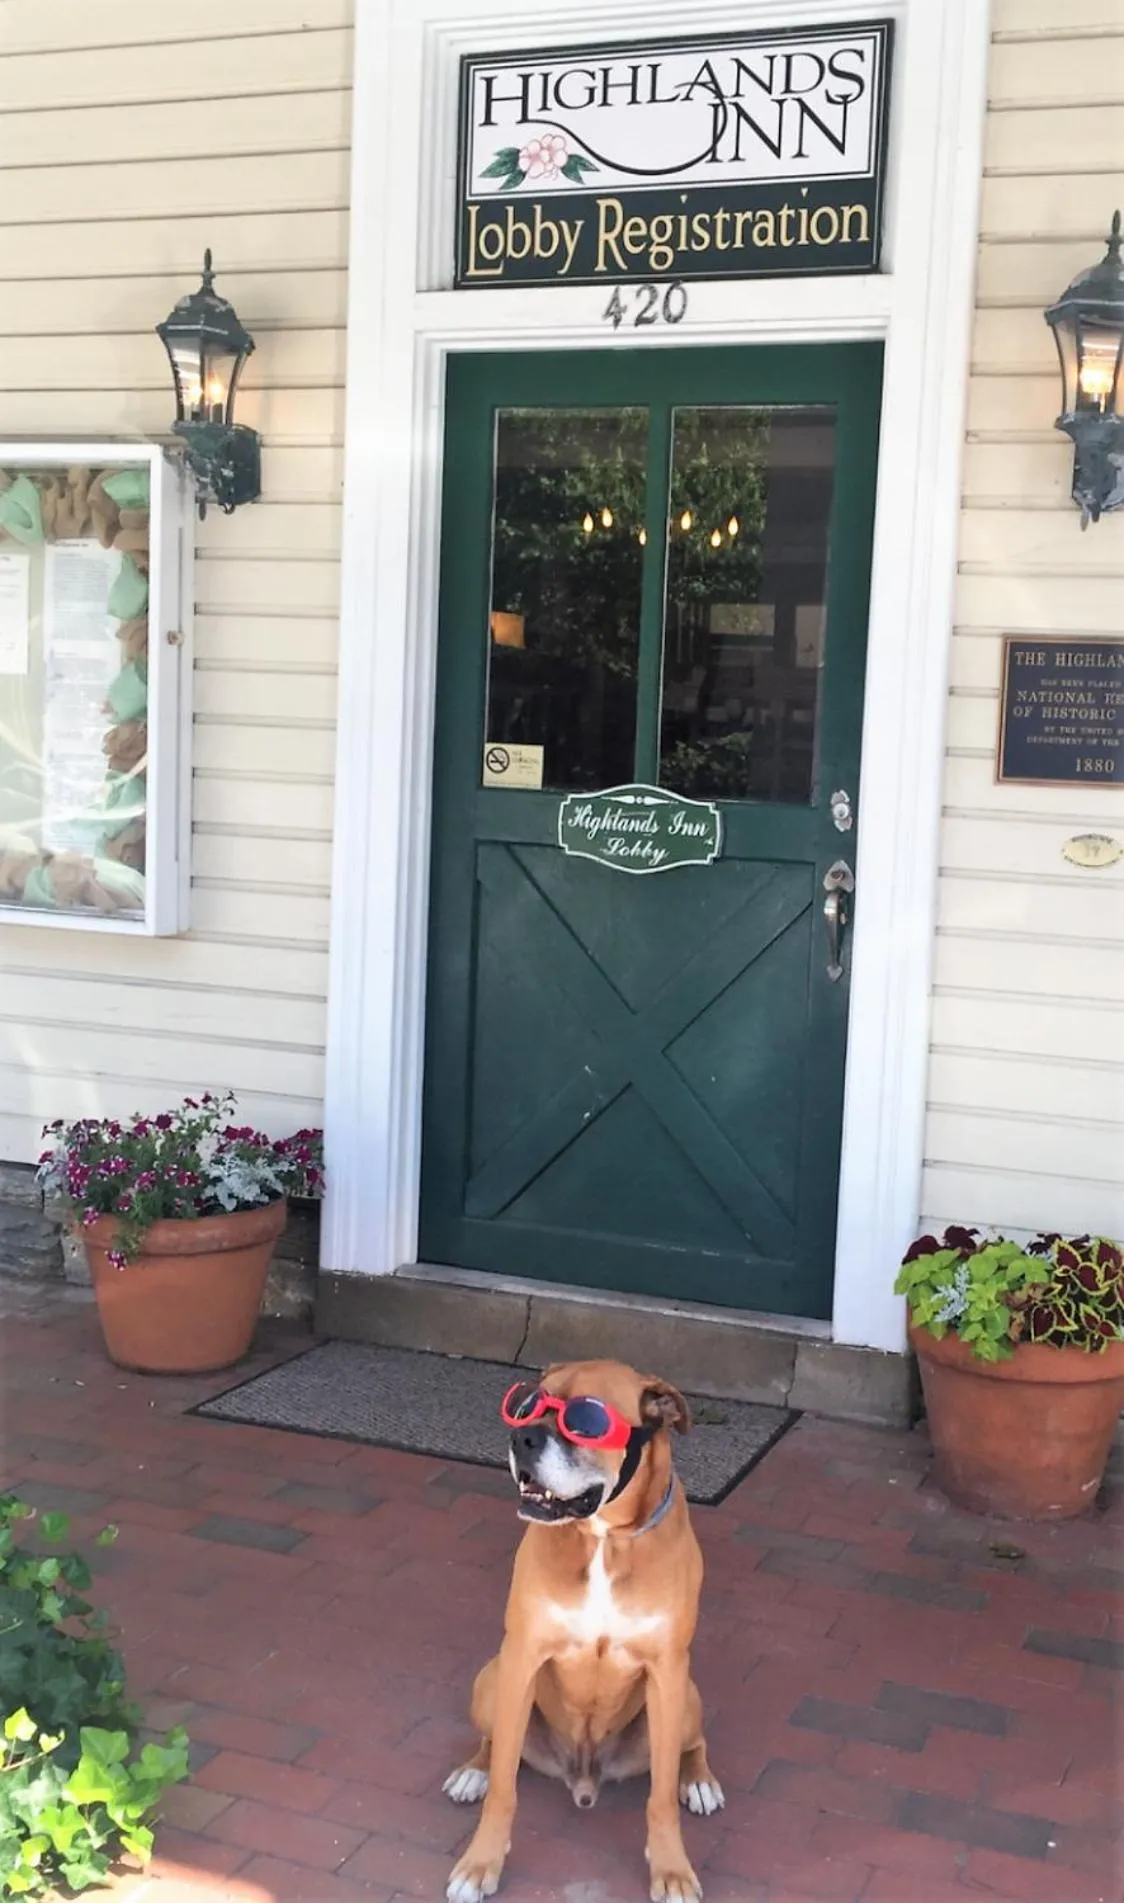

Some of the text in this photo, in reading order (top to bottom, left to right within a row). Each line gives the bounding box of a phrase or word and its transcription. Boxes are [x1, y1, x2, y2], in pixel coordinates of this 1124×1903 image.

[478, 49, 866, 127] HIGHLANDS
[705, 93, 853, 164] INN
[465, 187, 871, 276] Lobby Registration
[603, 281, 687, 330] 420
[1014, 652, 1046, 666] THE
[1012, 706, 1117, 720] OF HISTORIC
[1016, 690, 1096, 705] NATIONAL
[1075, 758, 1115, 773] 1880
[568, 804, 709, 841] Highlands Inn
[602, 837, 670, 865] Lobby
